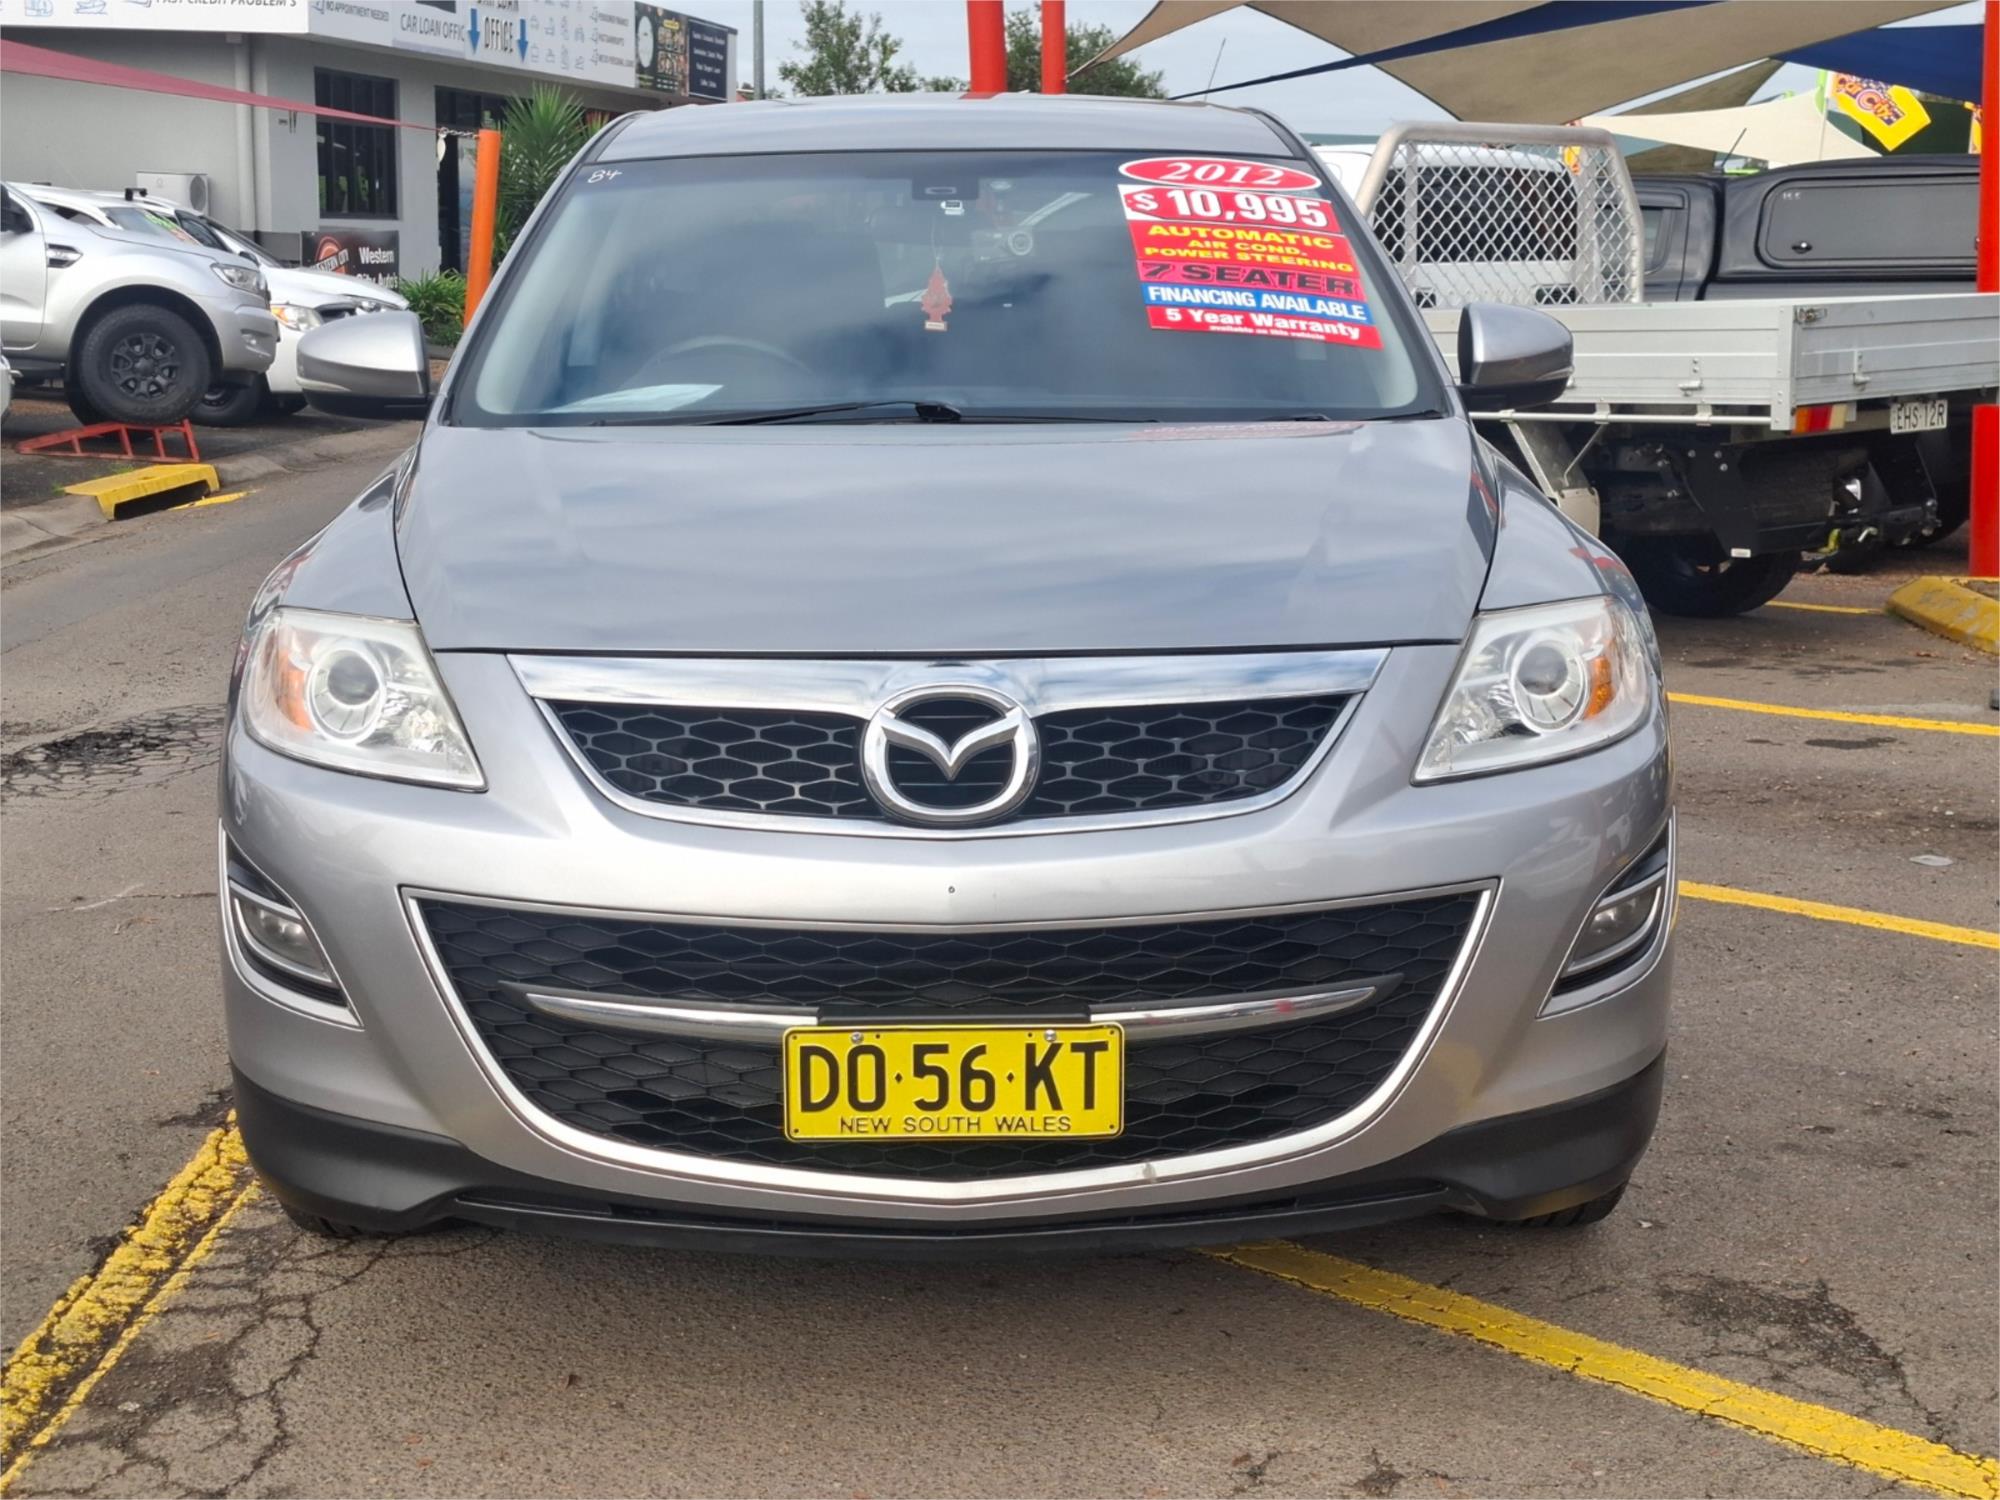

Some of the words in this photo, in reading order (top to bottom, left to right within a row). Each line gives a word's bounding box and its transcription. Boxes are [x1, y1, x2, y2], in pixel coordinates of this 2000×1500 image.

[400, 13, 417, 32] CAR
[419, 16, 441, 37] LOAN
[484, 16, 514, 53] OFFICE
[588, 169, 623, 183] 84
[1159, 162, 1285, 186] 2012
[1166, 189, 1329, 228] 10,995
[1148, 224, 1335, 249] AUTOMATIC
[1188, 239, 1229, 250] AIR
[1235, 241, 1308, 257] COND.
[359, 247, 395, 265] Western
[1144, 246, 1230, 261] POWER
[1236, 251, 1354, 272] STEERING
[1143, 262, 1175, 279] 7
[1181, 263, 1357, 295] SEATER
[1148, 286, 1255, 307] FINANCING
[1262, 293, 1367, 321] AVAILABLE
[1165, 308, 1182, 322] 5
[1188, 309, 1244, 326] Year
[1250, 312, 1361, 341] Warranty
[840, 1116, 890, 1134] NEW
[903, 1115, 981, 1133] SOUTH
[995, 1116, 1071, 1132] WALES
